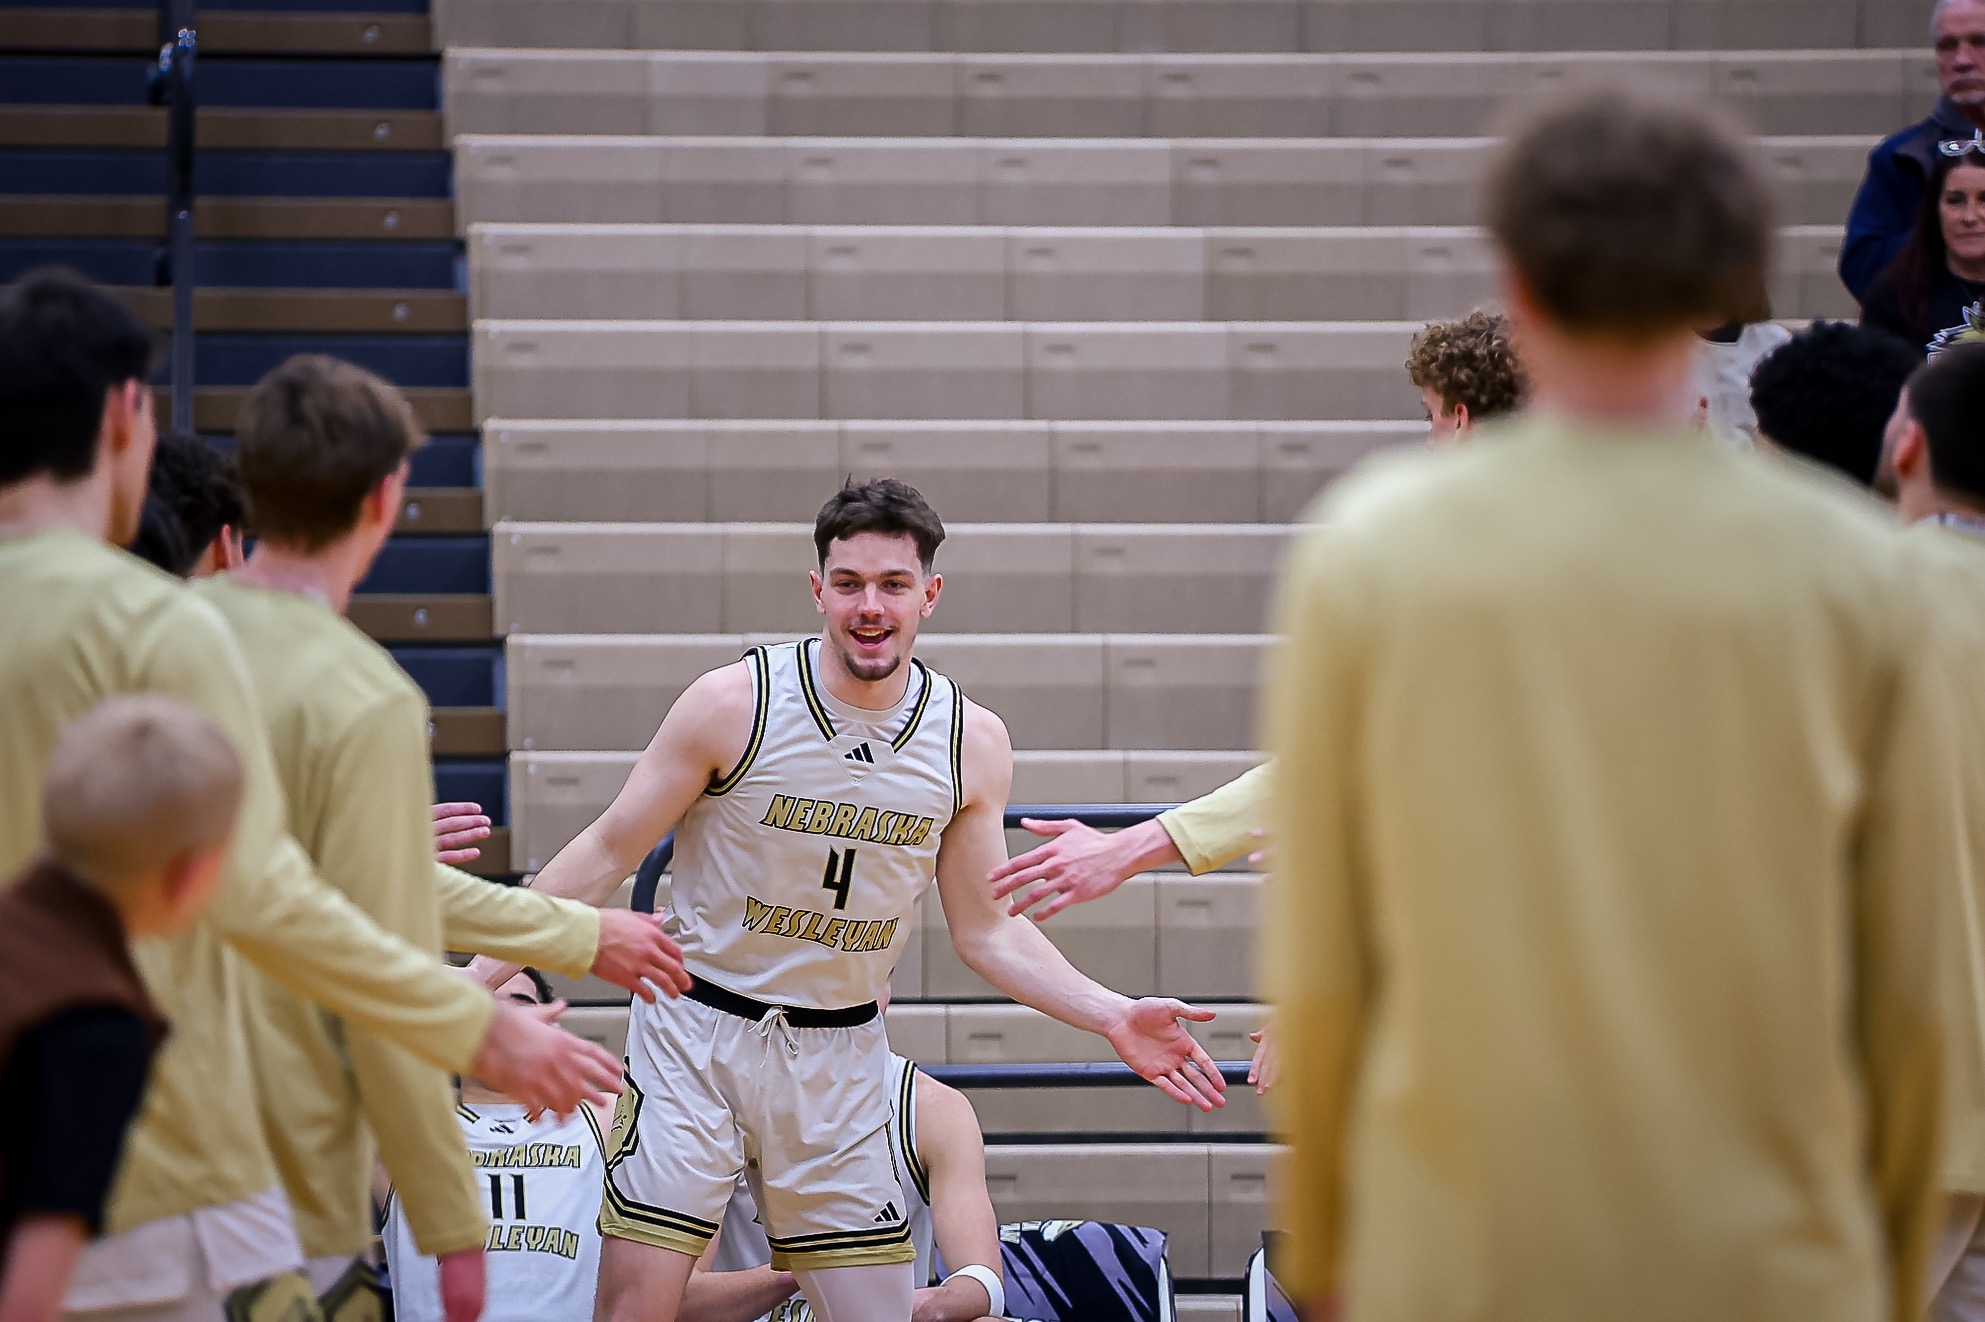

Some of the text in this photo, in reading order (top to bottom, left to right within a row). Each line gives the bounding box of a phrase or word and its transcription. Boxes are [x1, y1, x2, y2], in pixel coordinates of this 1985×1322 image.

[759, 794, 935, 846] NEBRASKA
[821, 844, 858, 912] 4
[741, 896, 900, 953] WESLEYAN
[468, 1142, 581, 1168] BRASKA
[487, 1172, 527, 1221] 11
[483, 1224, 580, 1260] LEYAN
